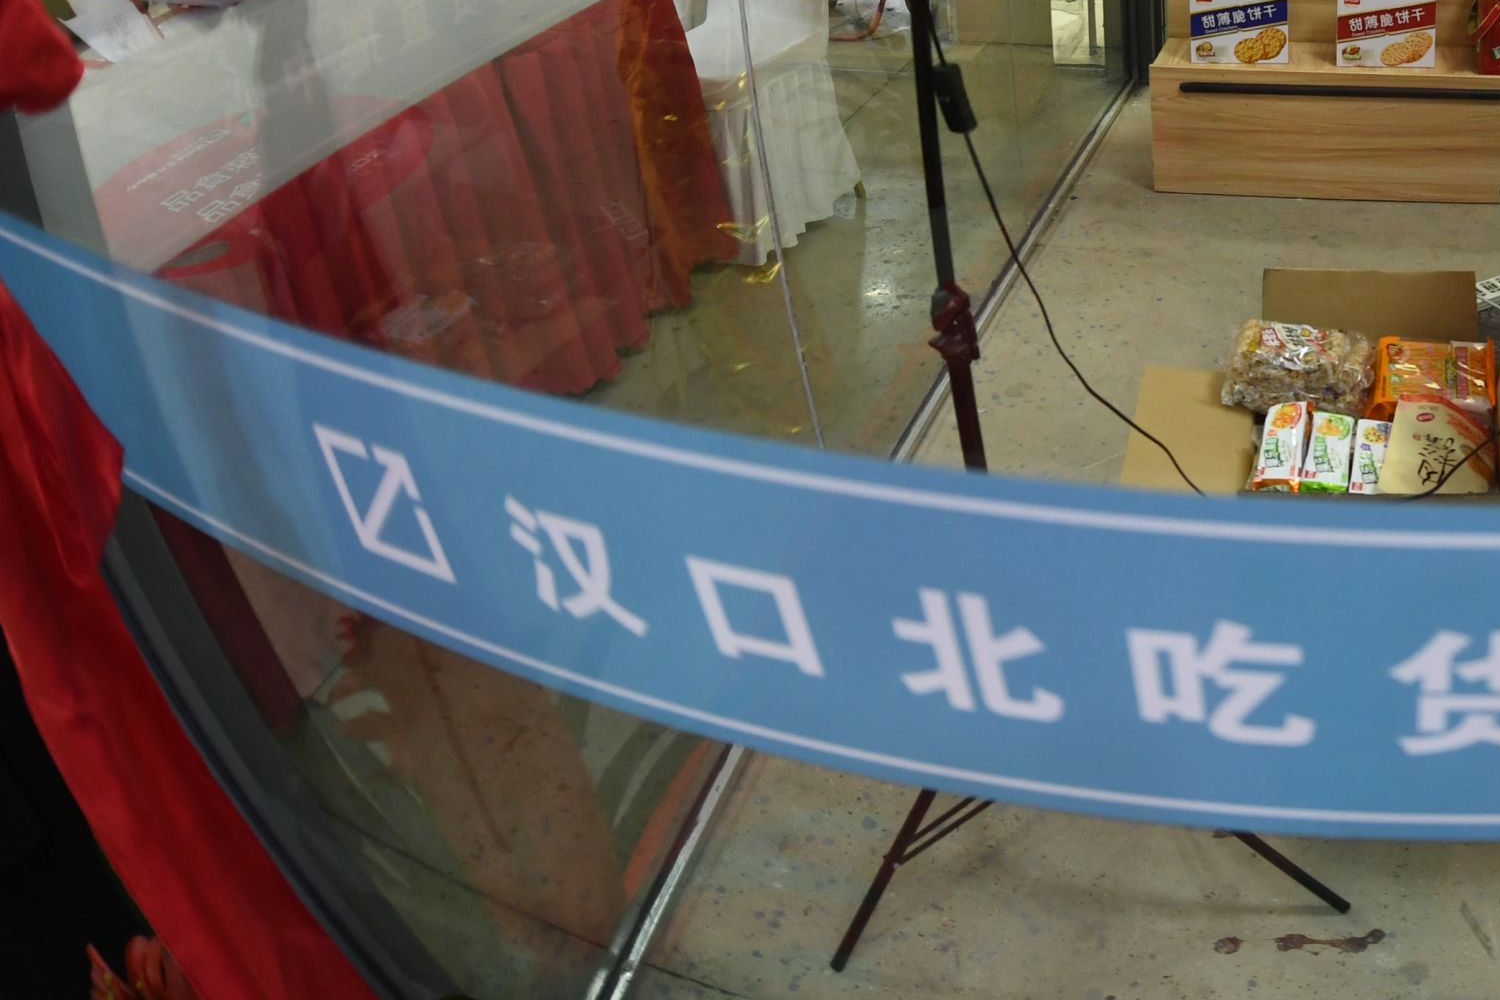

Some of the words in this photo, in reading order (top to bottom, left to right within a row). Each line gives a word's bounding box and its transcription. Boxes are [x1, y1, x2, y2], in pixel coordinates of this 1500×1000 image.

[1201, 4, 1278, 30] 甜薄脆饼干
[1348, 7, 1426, 33] 甜薄脆饼干
